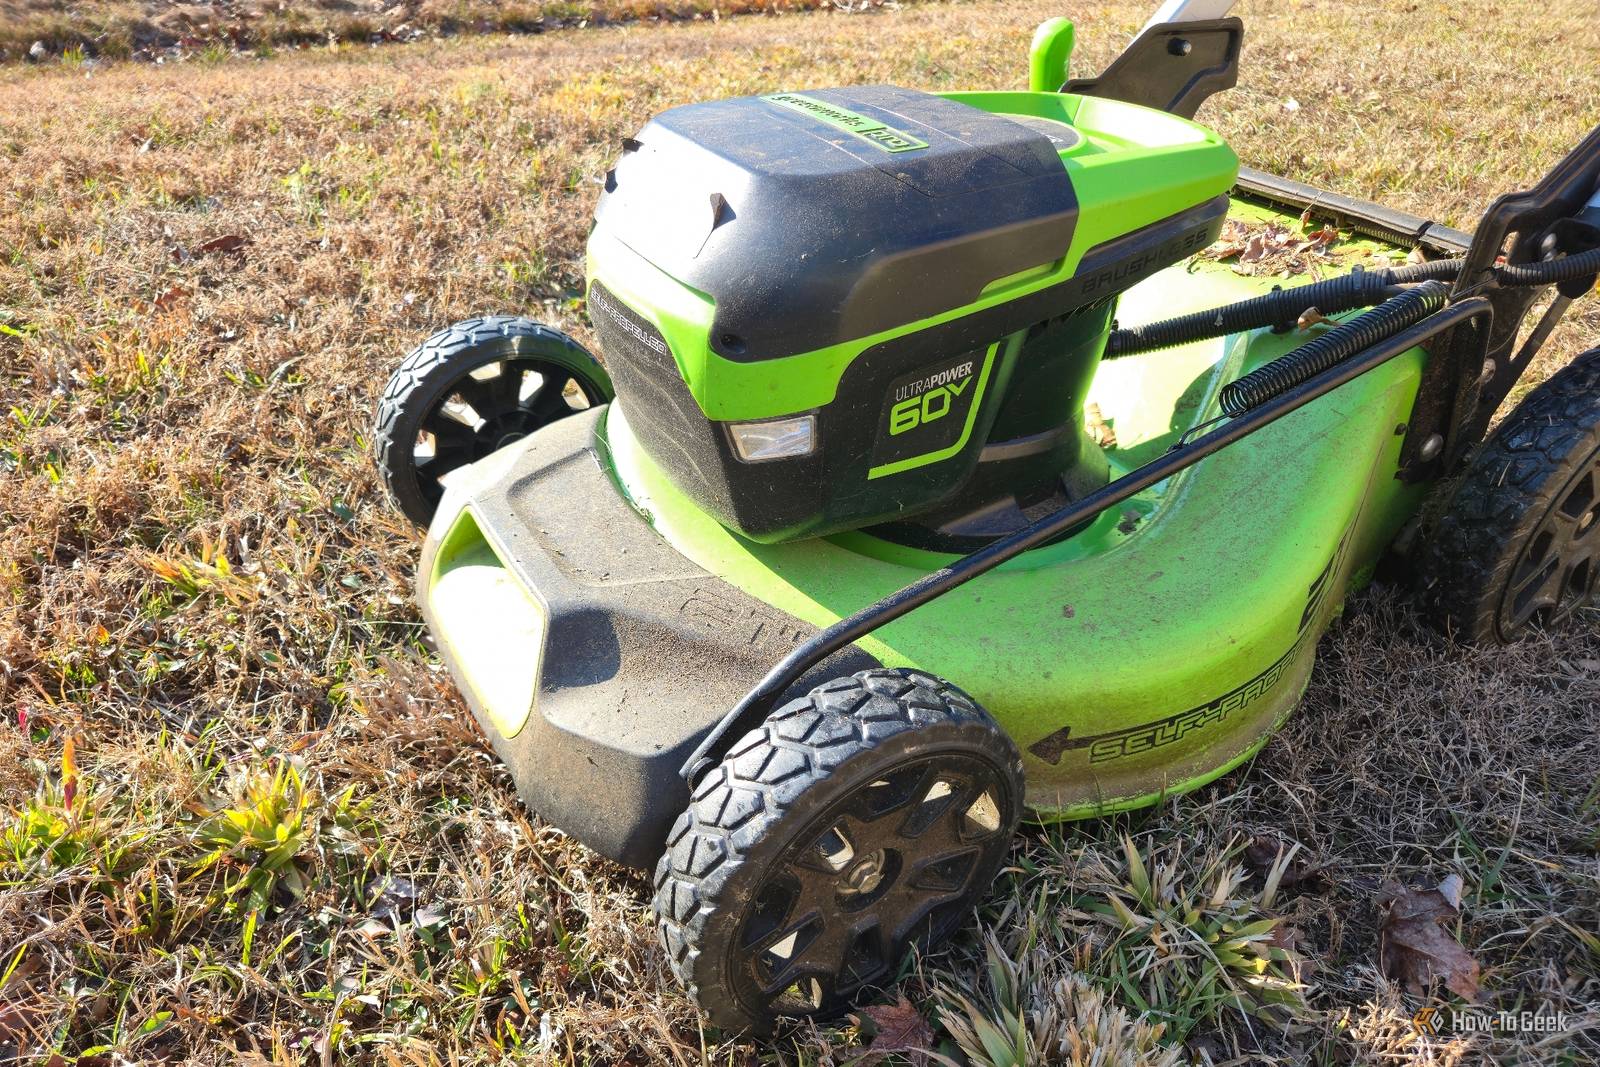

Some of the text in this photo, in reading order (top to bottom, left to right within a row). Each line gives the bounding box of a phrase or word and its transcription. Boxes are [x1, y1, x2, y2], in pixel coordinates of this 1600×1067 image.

[1080, 228, 1209, 293] BRUSHLESS
[890, 374, 974, 436] 60V
[895, 361, 974, 402] ULTRAPOWER
